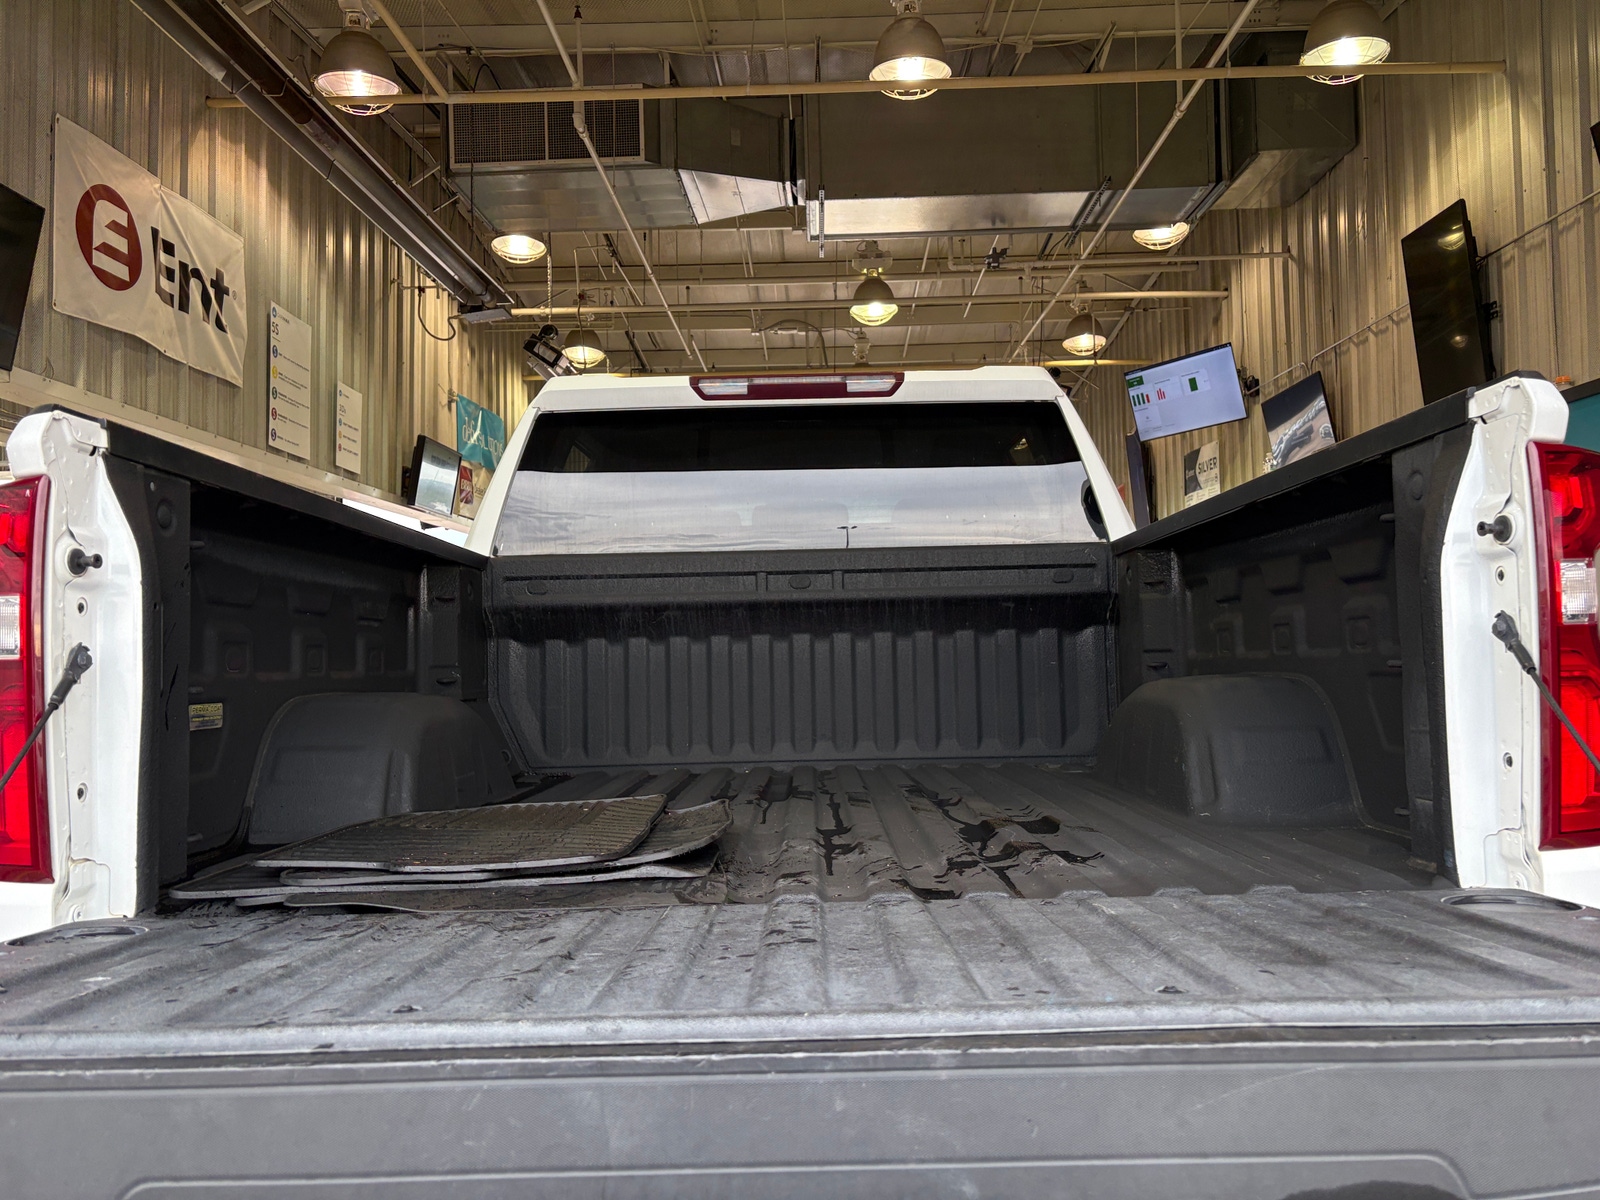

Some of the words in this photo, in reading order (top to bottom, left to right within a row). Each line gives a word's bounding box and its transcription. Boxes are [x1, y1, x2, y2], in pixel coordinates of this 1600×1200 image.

[151, 226, 229, 333] Ent
[272, 321, 279, 335] 5S
[1198, 456, 1217, 475] SILVER
